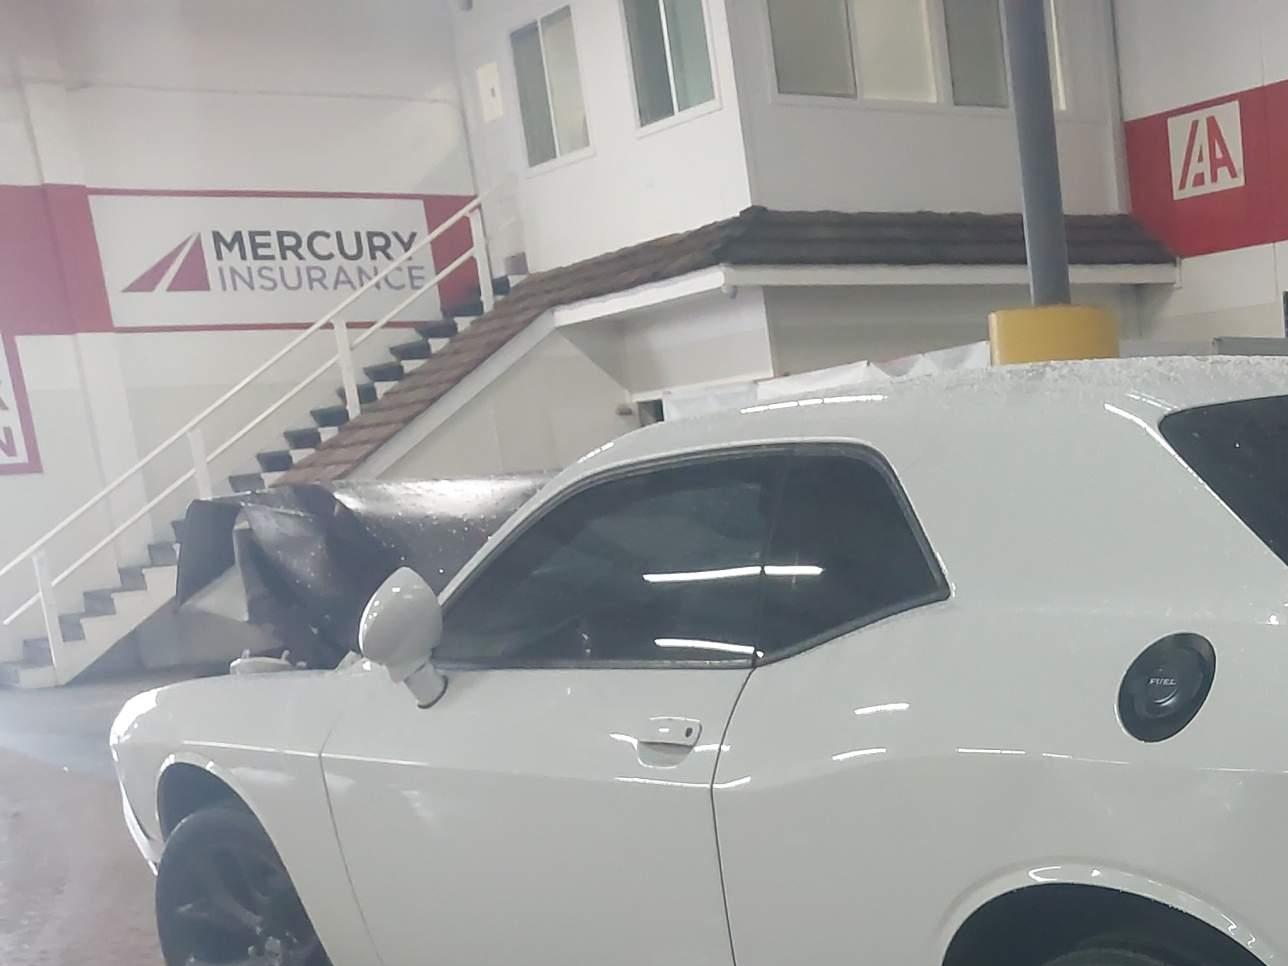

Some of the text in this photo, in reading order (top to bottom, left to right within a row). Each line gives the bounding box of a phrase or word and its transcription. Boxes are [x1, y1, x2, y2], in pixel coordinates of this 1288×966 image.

[211, 230, 417, 261] MERCURY
[218, 265, 425, 292] INSURANCE
[1148, 678, 1177, 686] FUEL
